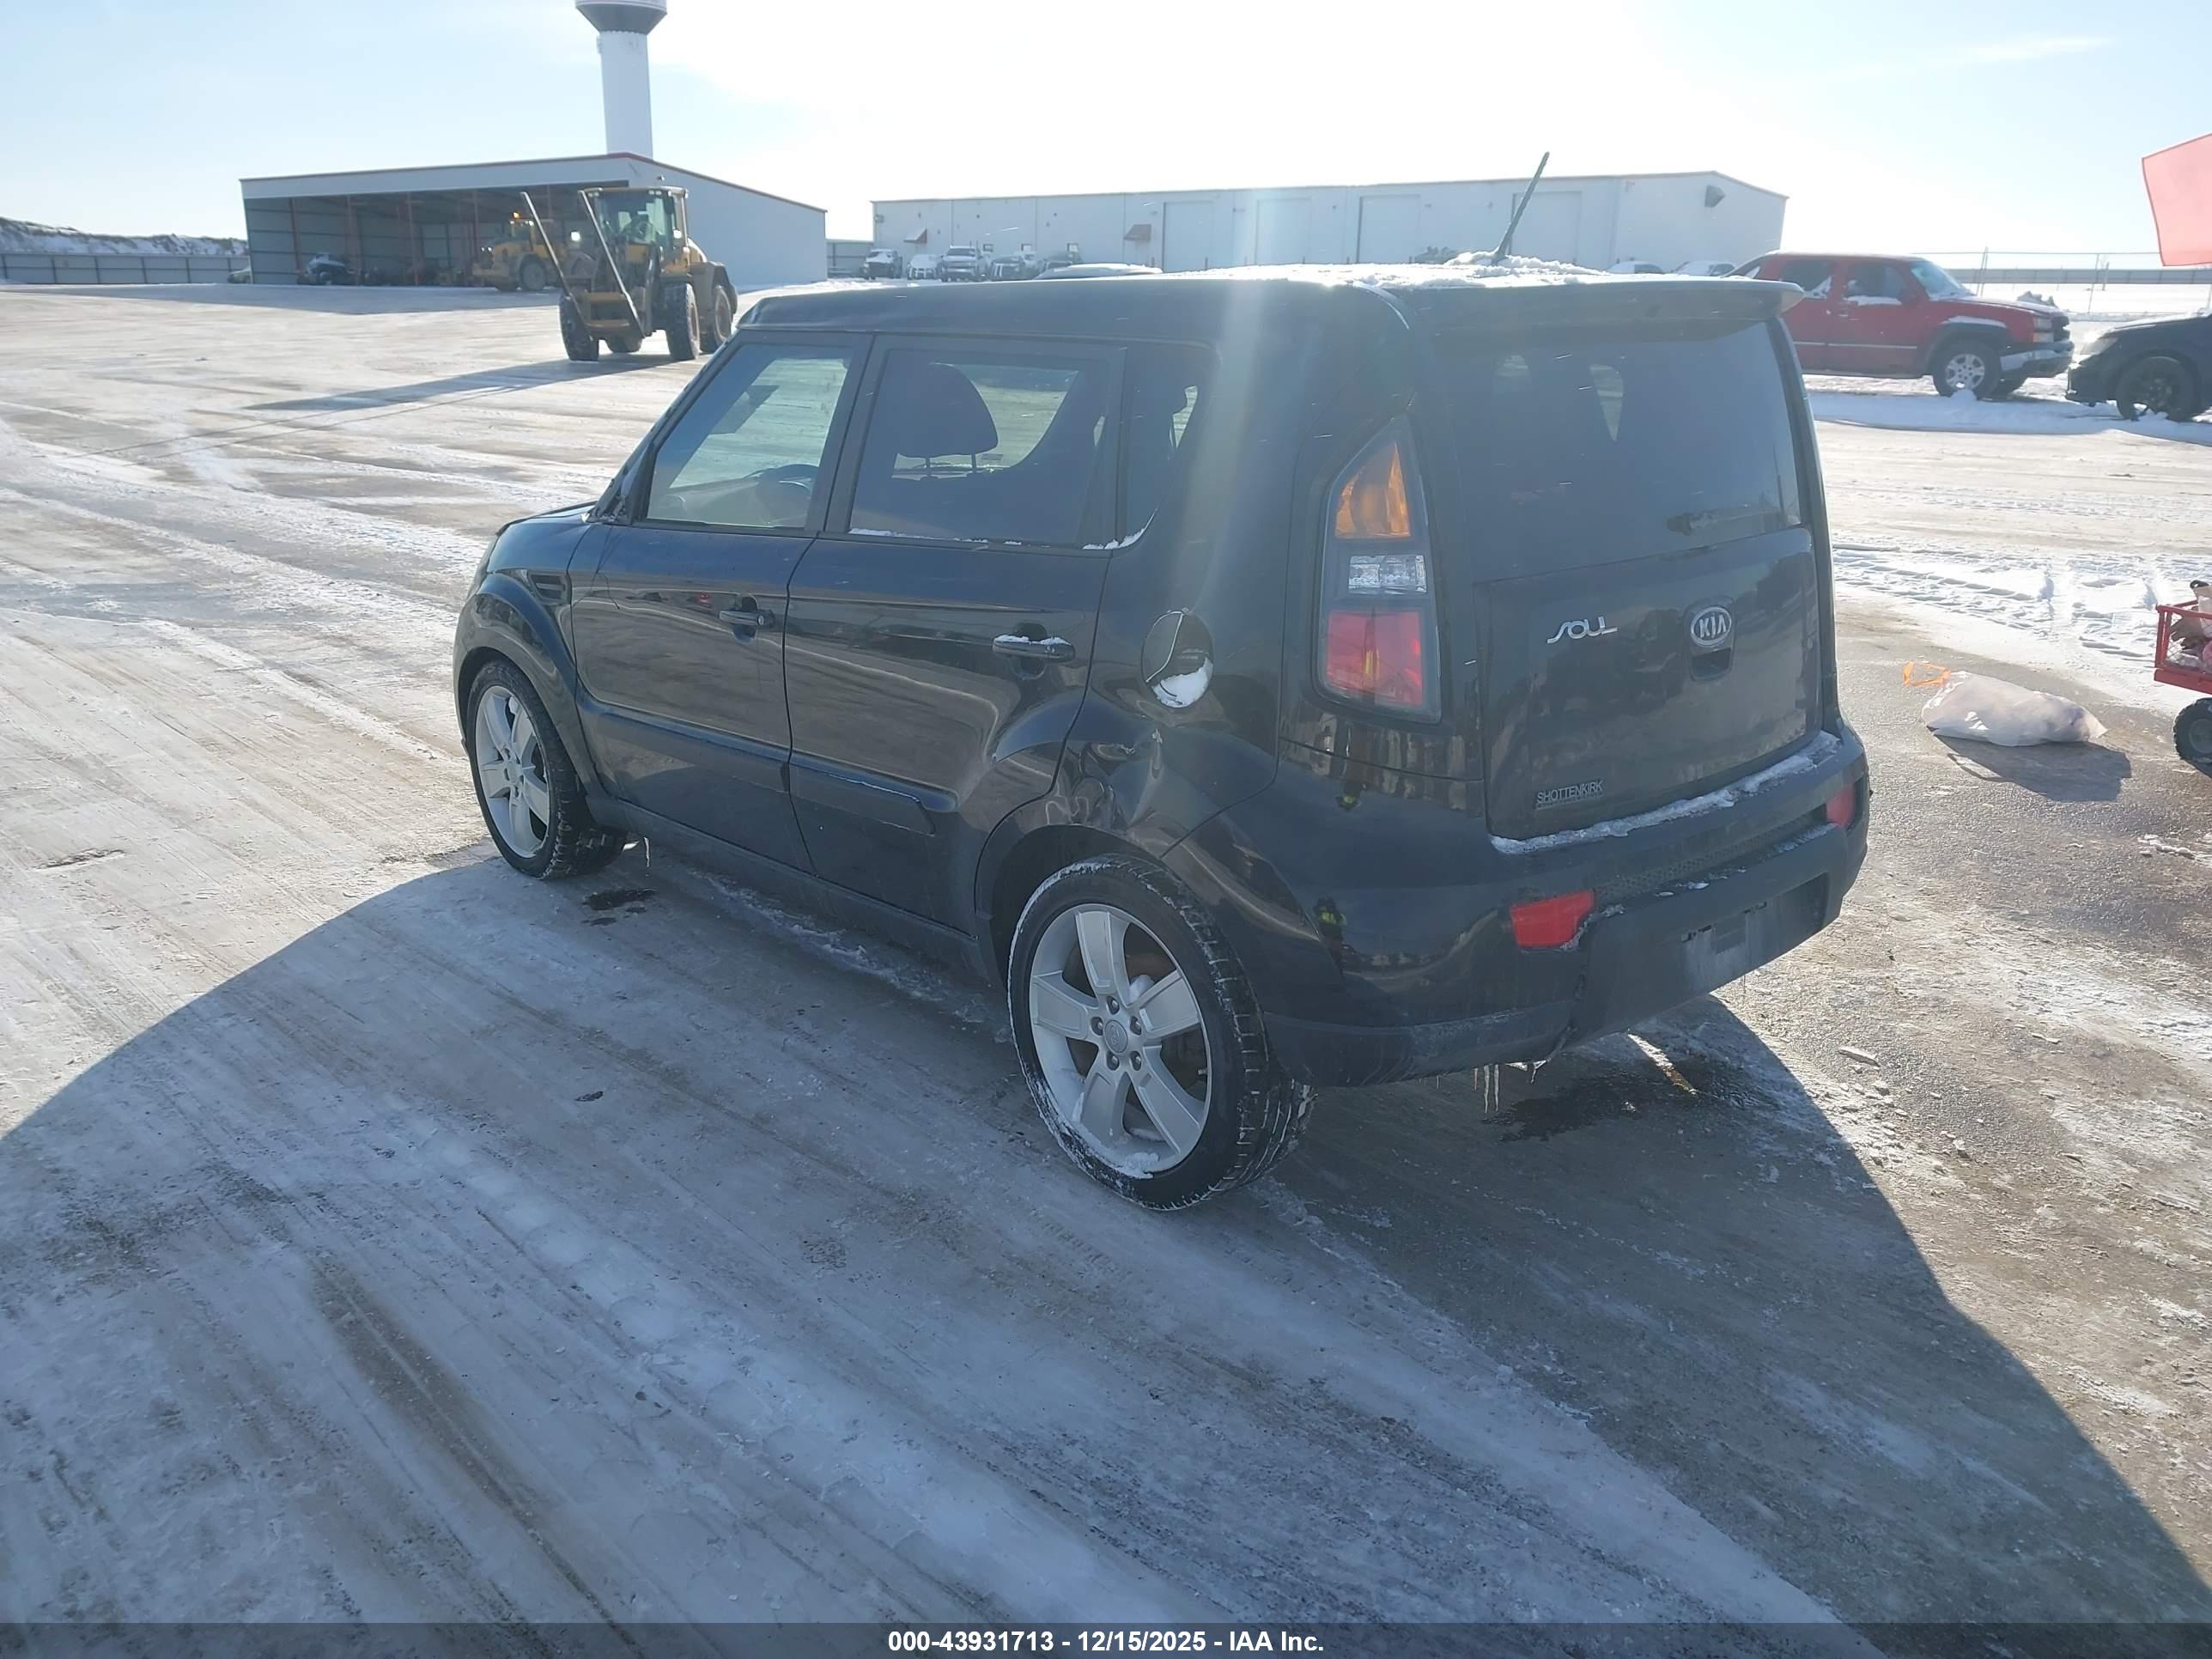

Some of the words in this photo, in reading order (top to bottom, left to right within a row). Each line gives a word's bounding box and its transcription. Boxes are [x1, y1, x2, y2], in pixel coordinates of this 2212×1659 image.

[1547, 616, 1618, 643] SOUL
[1697, 612, 1729, 640] KIA
[1536, 780, 1603, 805] SHOTTENKIRK
